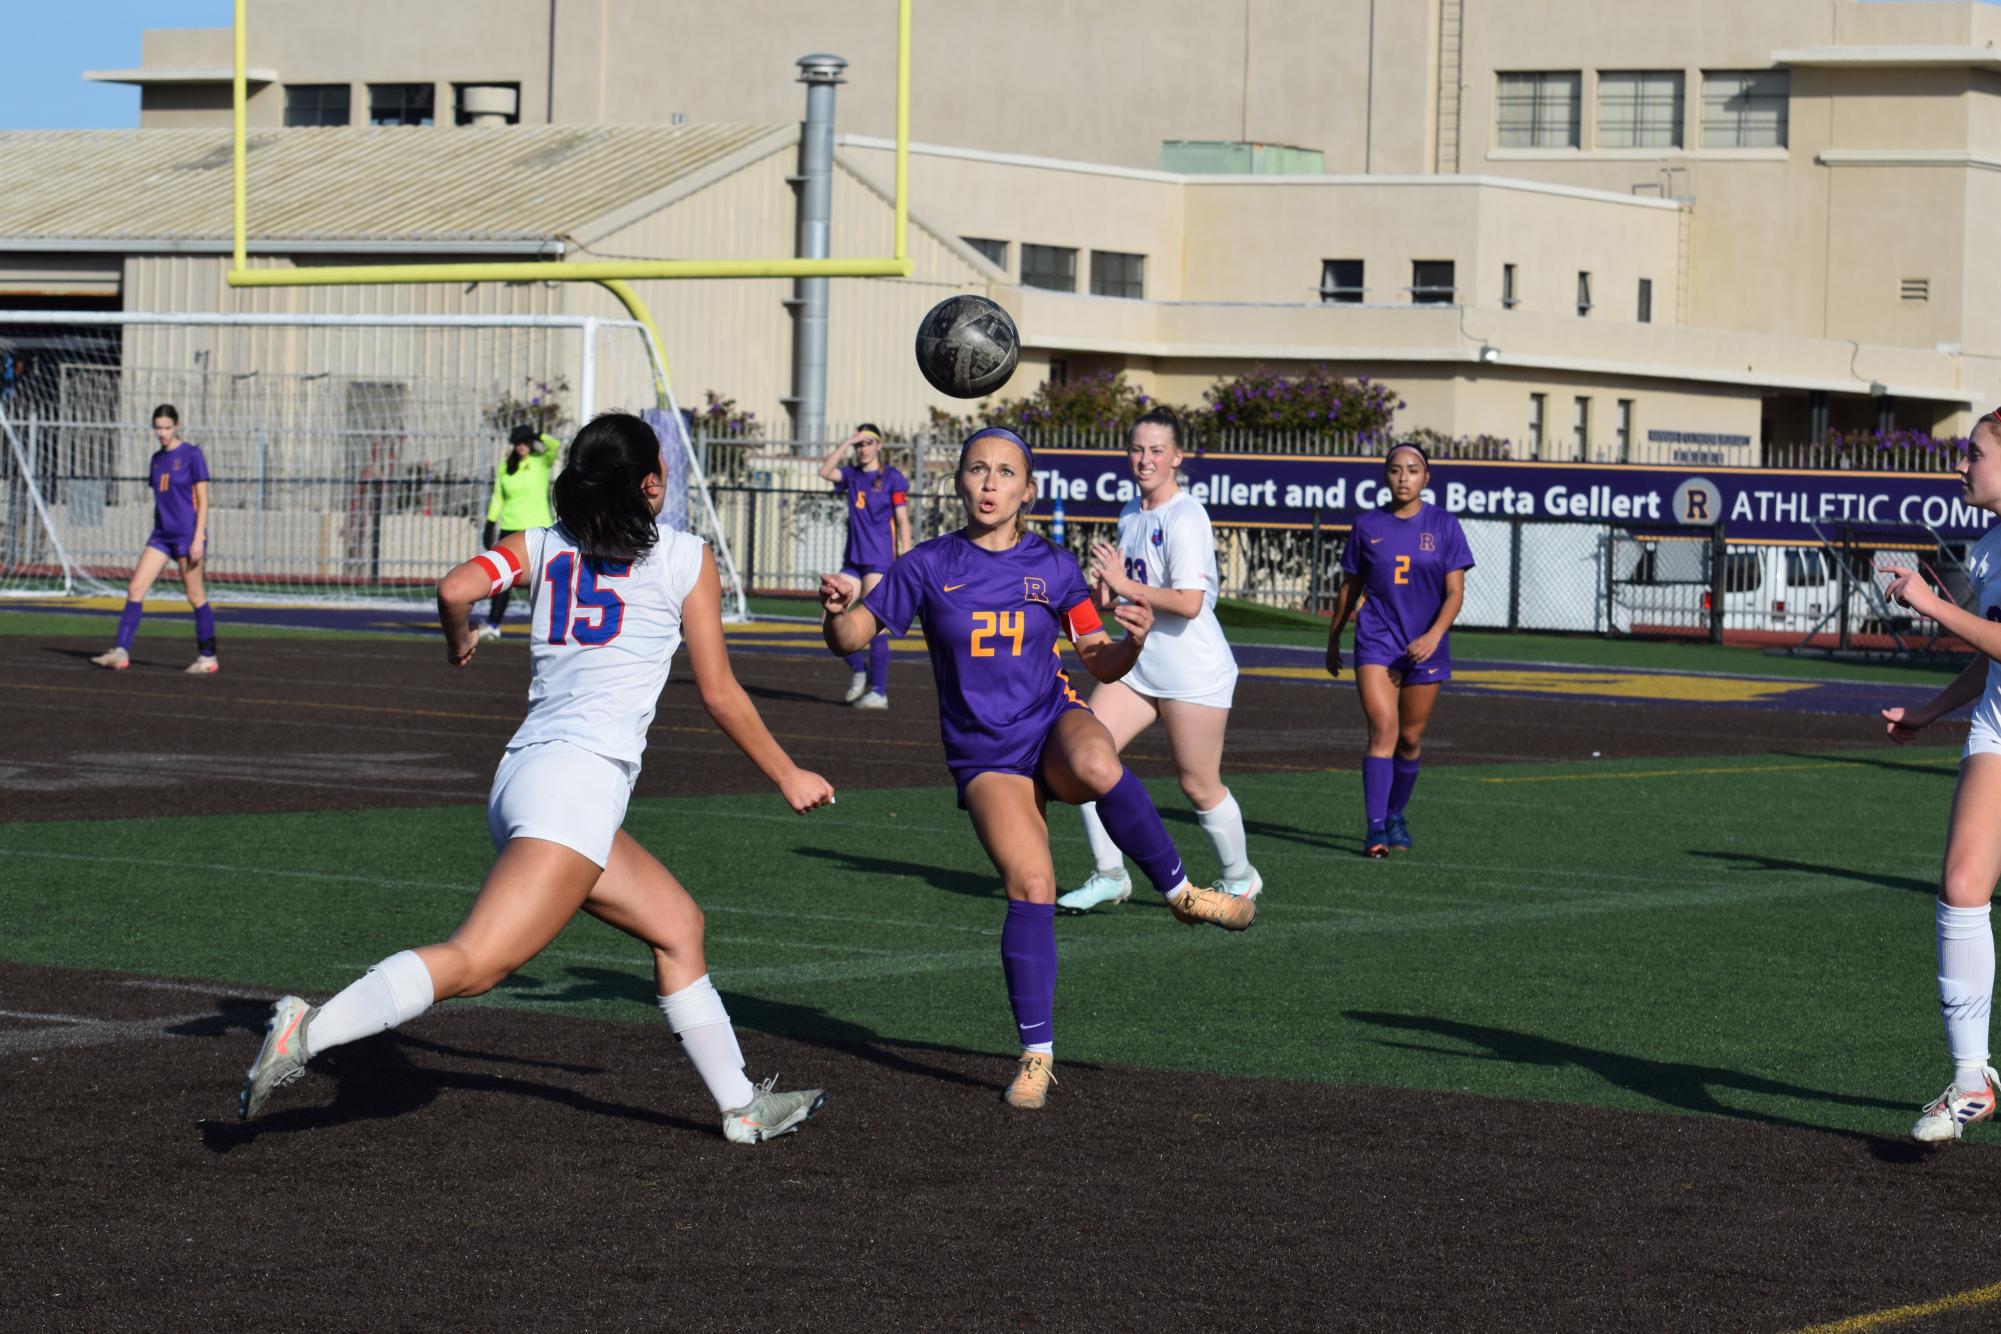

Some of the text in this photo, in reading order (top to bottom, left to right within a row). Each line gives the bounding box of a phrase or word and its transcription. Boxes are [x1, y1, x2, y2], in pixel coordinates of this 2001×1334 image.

[1032, 469, 1088, 501] The
[1095, 472, 1142, 502] Ca
[1284, 478, 1347, 509] and
[1354, 479, 1436, 509] Cea
[1446, 482, 1535, 514] Berta
[1543, 485, 1662, 519] Gellert
[1686, 489, 1708, 520] R
[1730, 490, 1890, 523] ATHLETIC
[1420, 532, 1436, 551] R
[1394, 555, 1411, 585] 2
[545, 550, 635, 646] 15
[1024, 576, 1049, 604] R
[970, 610, 1025, 657] 24
